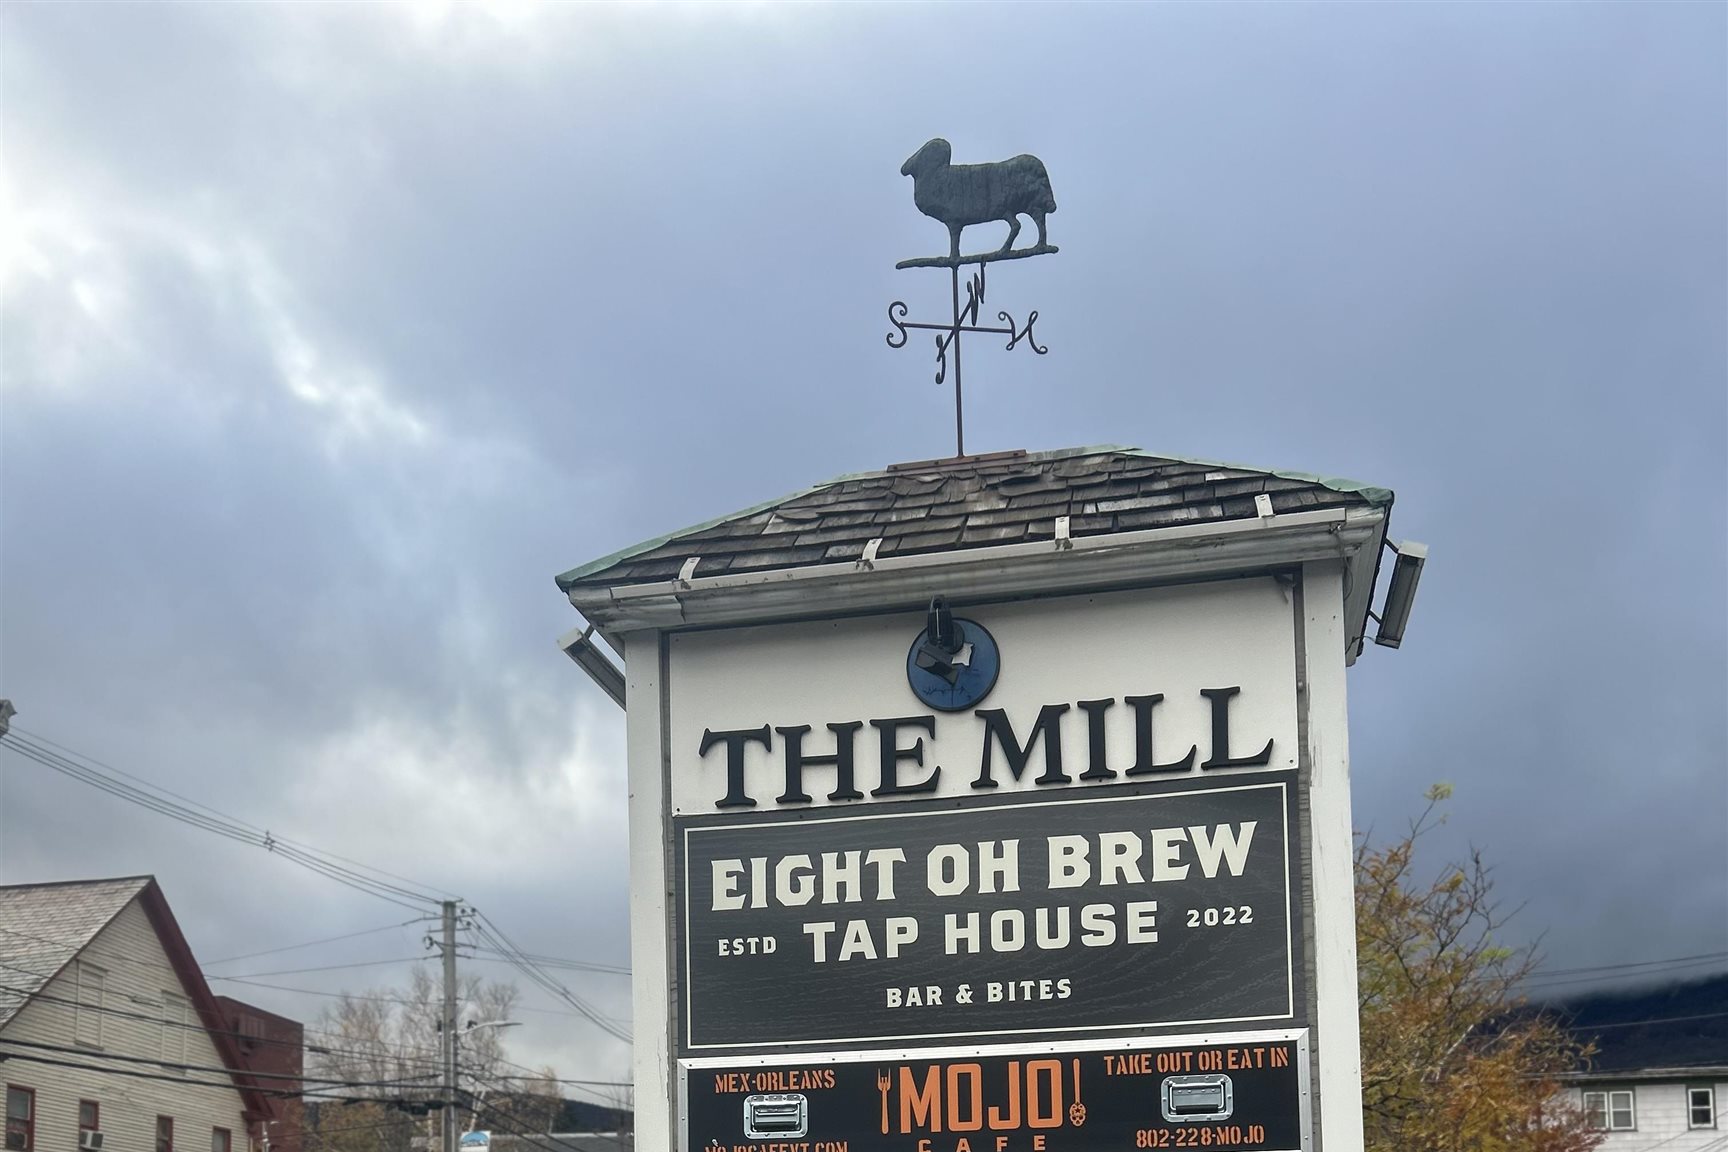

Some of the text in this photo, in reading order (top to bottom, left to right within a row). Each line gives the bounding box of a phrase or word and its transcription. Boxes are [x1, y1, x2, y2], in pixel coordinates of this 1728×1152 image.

[698, 686, 1274, 810] THE MILL
[710, 820, 1258, 912] EIGHT OH BREW
[1186, 905, 1254, 928] 2022
[802, 900, 1159, 963] TAP HOUSE
[718, 936, 777, 957] ESTD
[886, 978, 1072, 1008] BAR & BITES
[1104, 1047, 1288, 1074] TAKE OUT OR EAT IN
[716, 1071, 834, 1092] MEX-ORLEANS
[1136, 1126, 1265, 1148] 802-228-MOJO
